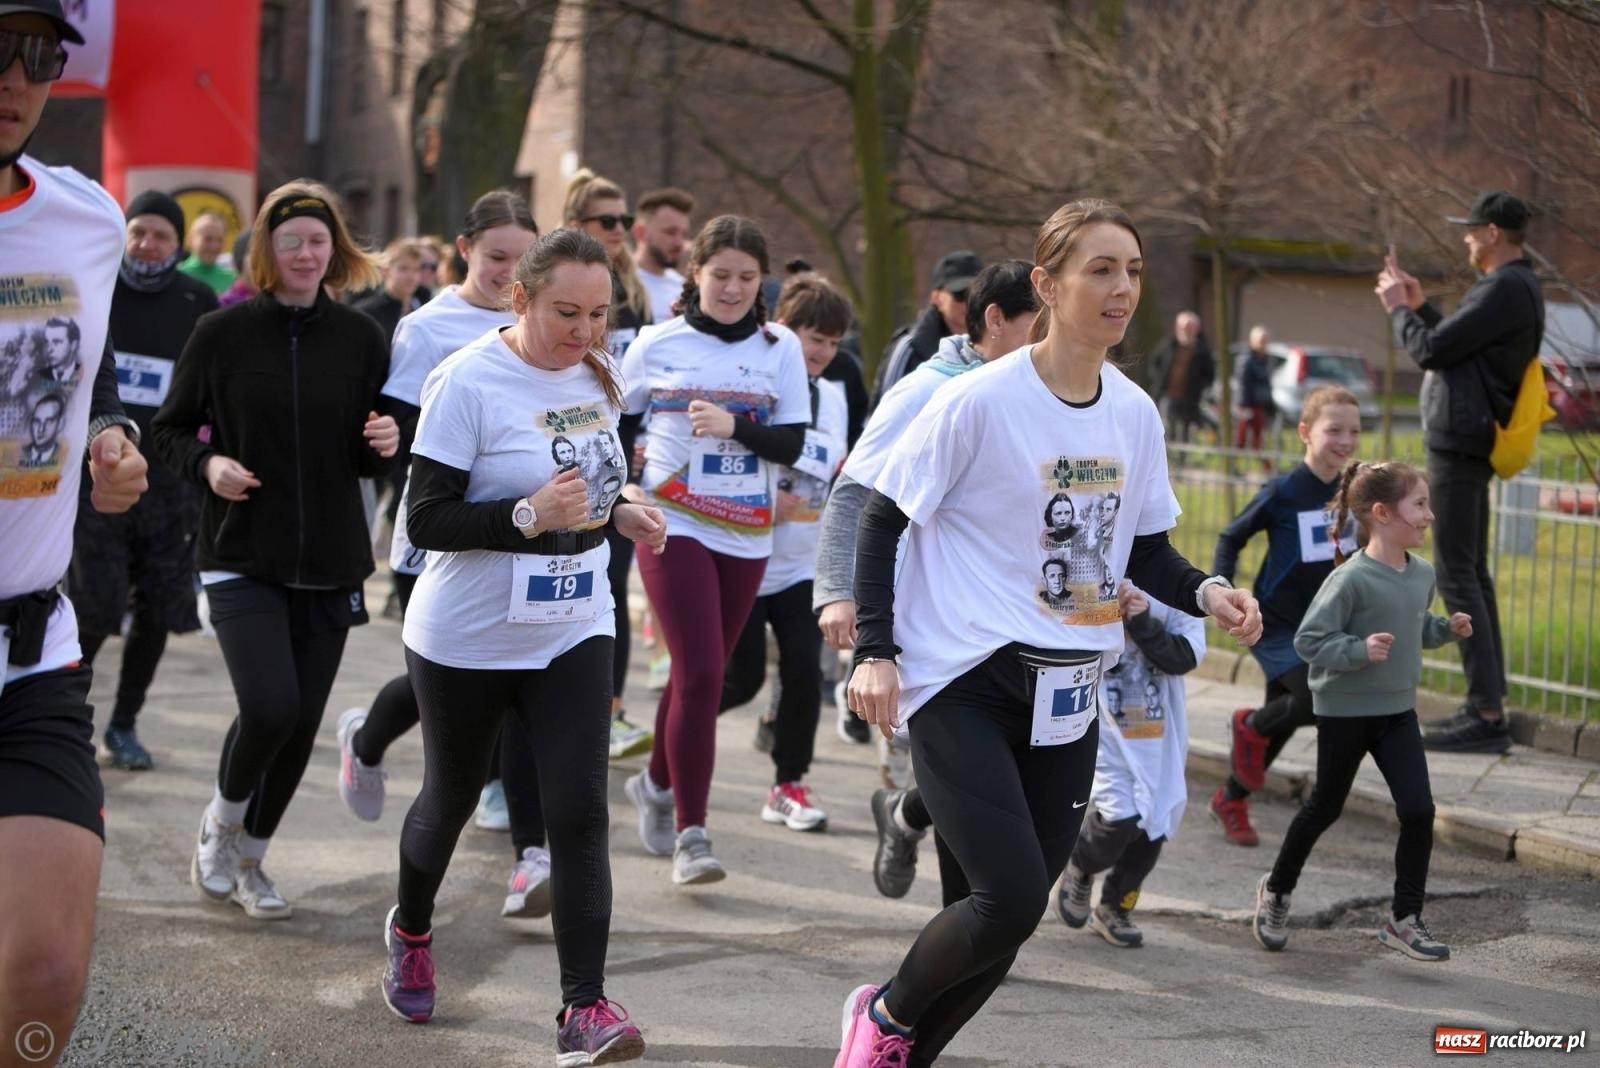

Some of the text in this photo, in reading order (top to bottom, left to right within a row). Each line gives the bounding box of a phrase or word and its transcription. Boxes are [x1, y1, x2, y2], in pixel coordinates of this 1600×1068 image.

[720, 456, 745, 473] 86
[1076, 460, 1098, 468] TROPEM
[1077, 468, 1117, 481] WILCZYM
[695, 494, 755, 515] OMAGAMY
[552, 576, 577, 599] 19
